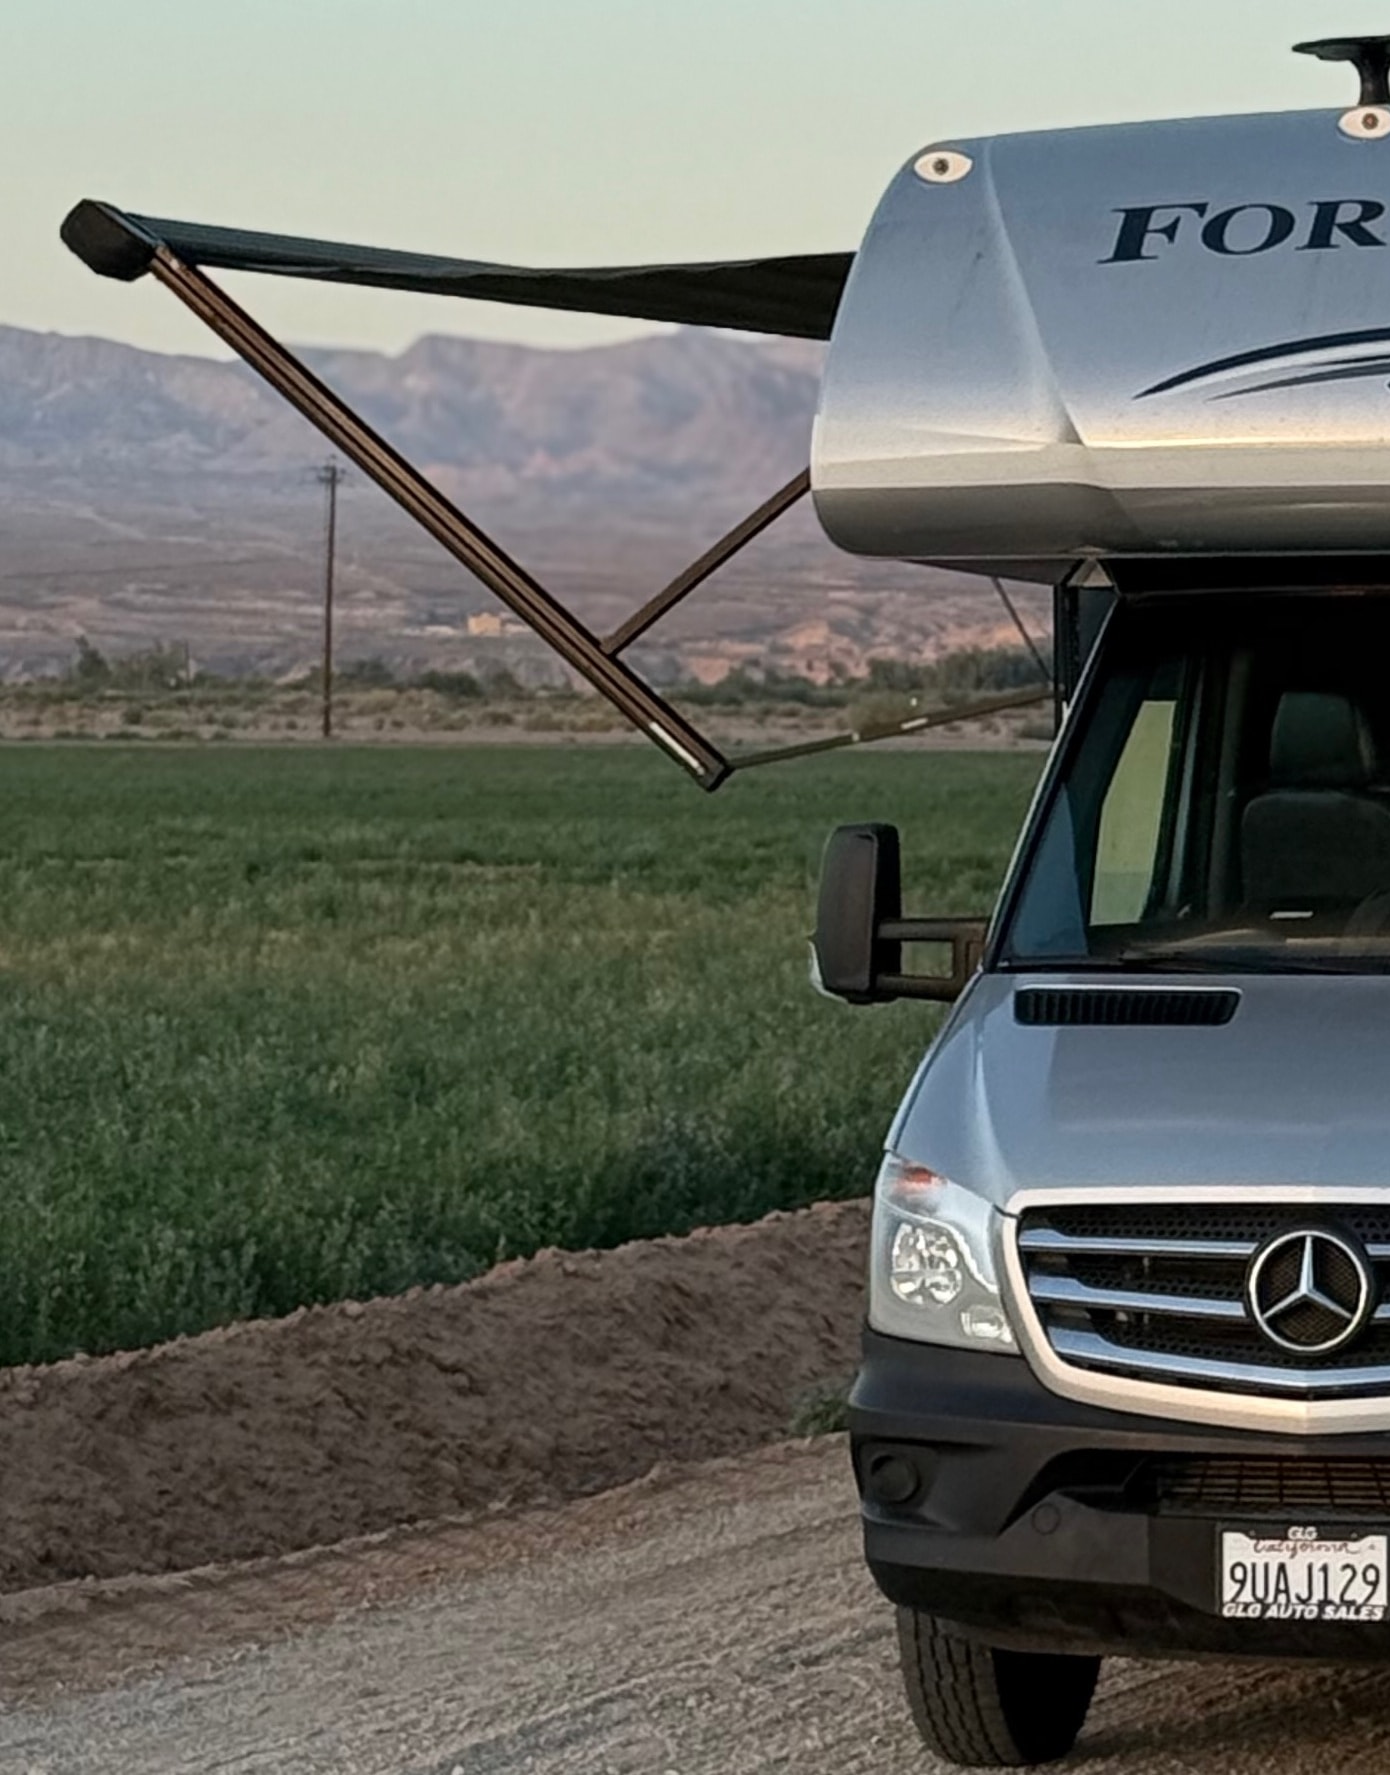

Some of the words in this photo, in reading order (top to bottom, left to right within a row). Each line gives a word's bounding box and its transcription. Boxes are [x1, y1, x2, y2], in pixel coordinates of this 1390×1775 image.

[1287, 1526, 1318, 1541] GLG
[1229, 1561, 1381, 1606] 9UAJ129
[1222, 1601, 1263, 1618] GLG
[1264, 1602, 1319, 1620] AUTO
[1321, 1604, 1385, 1621] SALES
